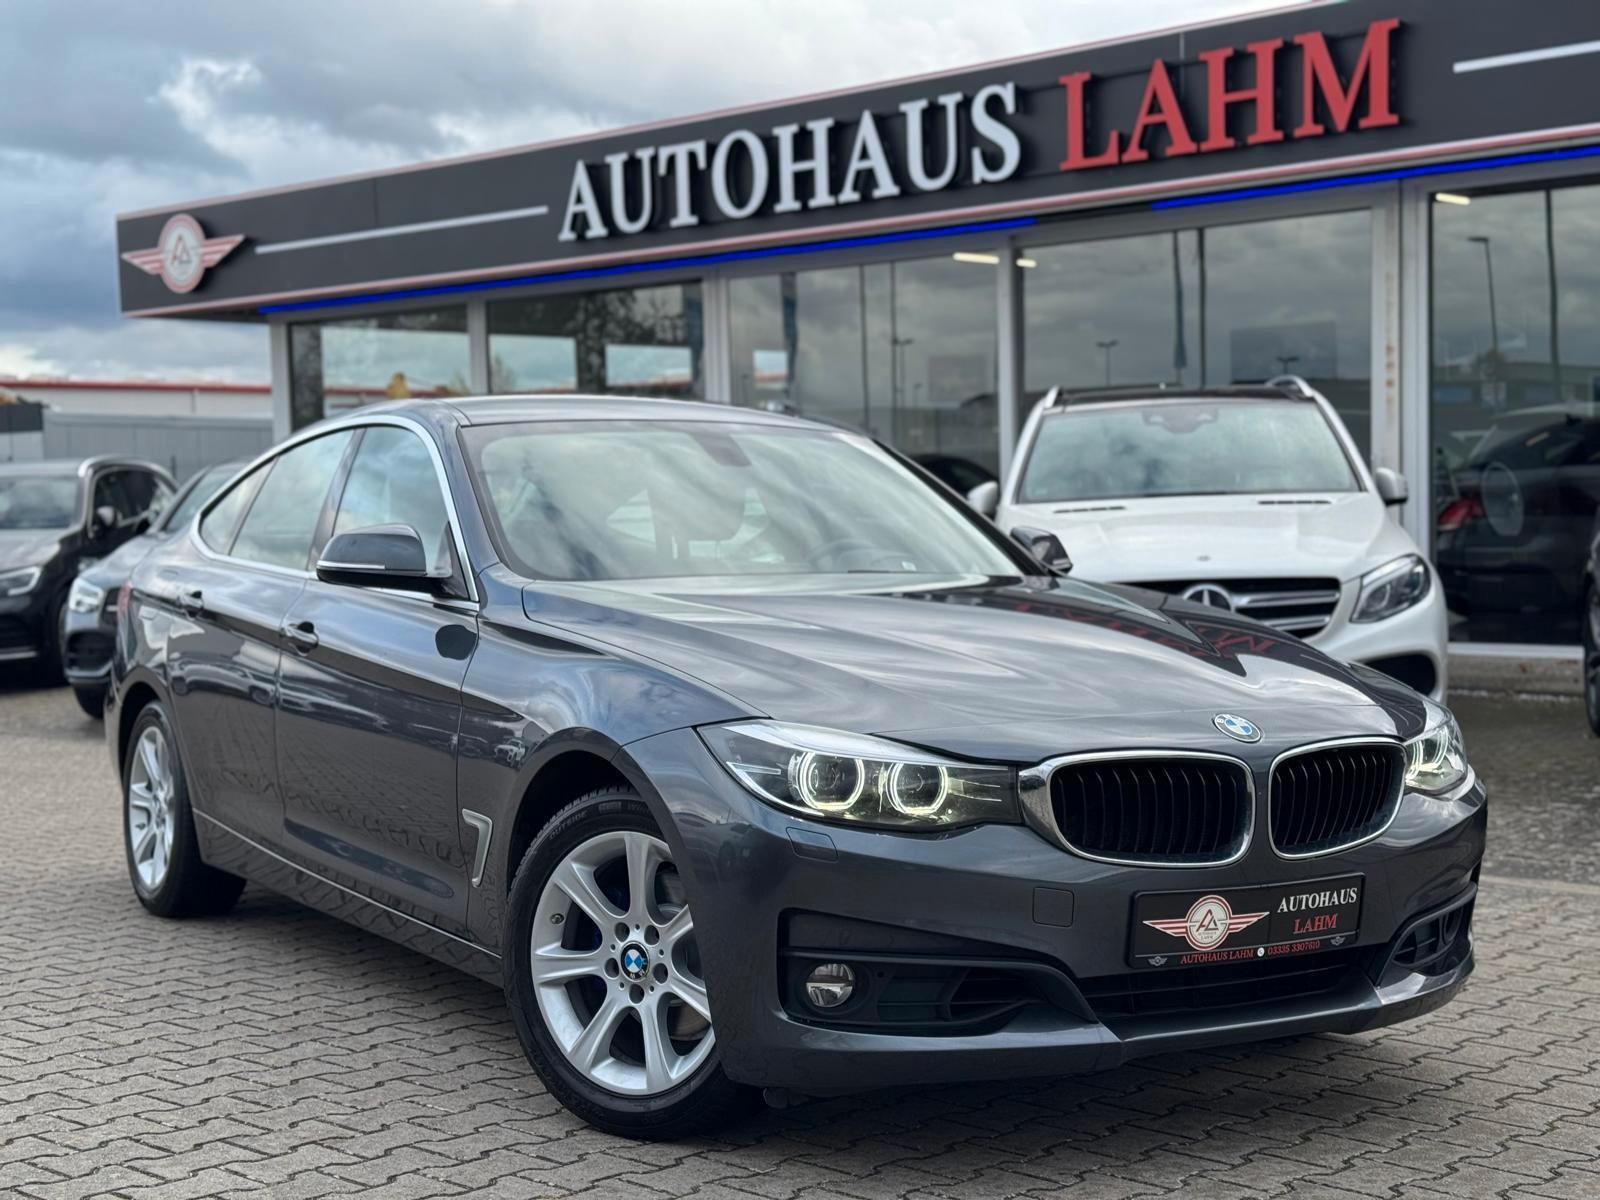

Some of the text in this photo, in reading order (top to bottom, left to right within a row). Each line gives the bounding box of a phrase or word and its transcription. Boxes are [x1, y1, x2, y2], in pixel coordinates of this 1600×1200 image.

[558, 18, 1400, 242] AUTOHAUS LAHM
[1277, 887, 1358, 913] AUTOHAUS
[1293, 913, 1338, 934] LAHM
[1181, 951, 1228, 964] AUTOHAUS
[1230, 949, 1254, 960] LAHM
